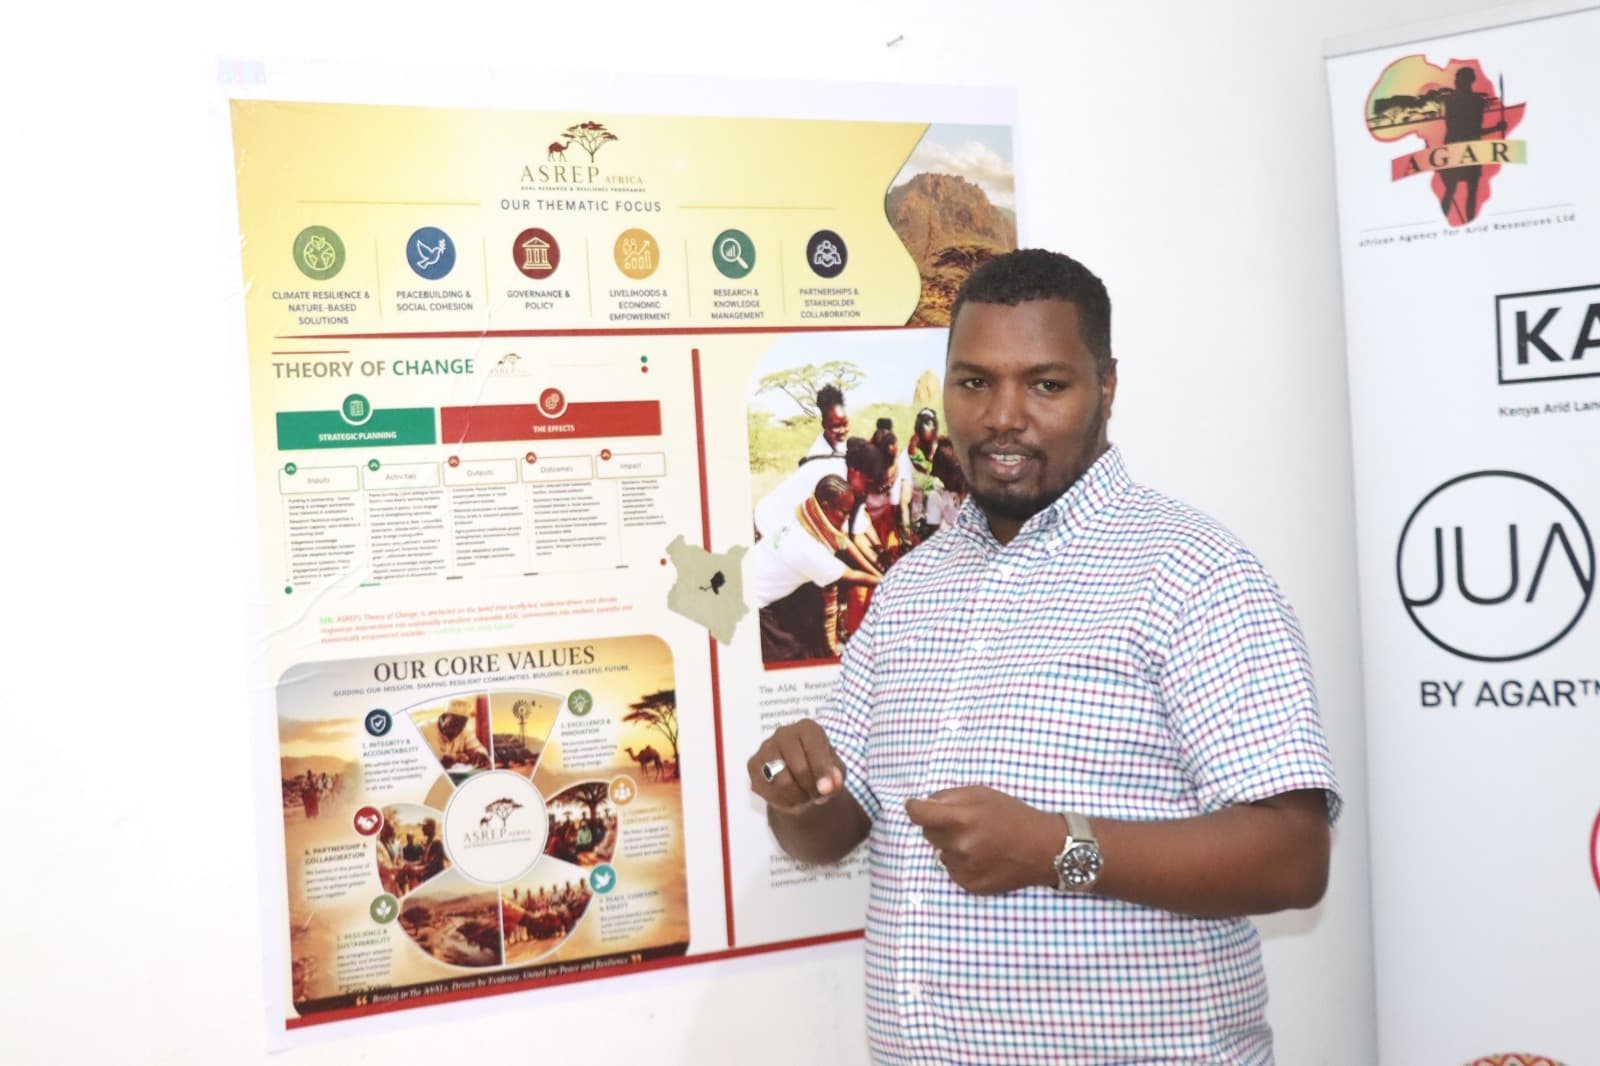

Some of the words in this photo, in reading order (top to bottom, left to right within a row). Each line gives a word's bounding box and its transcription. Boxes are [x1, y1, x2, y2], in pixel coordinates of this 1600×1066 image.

[1403, 142, 1511, 176] AGAR
[520, 165, 599, 183] ASREP
[605, 176, 643, 184] AFRICA
[500, 199, 530, 211] OUR
[537, 199, 609, 212] THEMATIC
[616, 200, 661, 212] FOCUS
[1400, 232, 1438, 243] Agency
[1494, 218, 1551, 230] Resources
[1557, 214, 1575, 223] Ltd
[272, 291, 310, 300] CLIMATE
[313, 291, 360, 300] RESILIENCE
[362, 291, 370, 299] &
[396, 290, 463, 299] PEACEBUILDING
[465, 290, 471, 298] &
[507, 290, 562, 298] GOVERNANCE
[564, 290, 570, 298] &
[609, 289, 659, 297] LIVELIHOODS
[662, 289, 668, 297] &
[713, 289, 751, 297] RESEARCH
[799, 288, 852, 296] PARTNERSHIPS
[854, 288, 859, 296] &
[288, 303, 356, 312] NATURE-BASED
[397, 303, 426, 311] SOCIAL
[429, 303, 473, 311] COHESION
[525, 302, 554, 310] POLICY
[618, 301, 661, 309] ECONOMIC
[713, 300, 760, 308] KNOWLEDGE
[804, 299, 855, 307] STAKEHOLDER
[609, 313, 670, 321] EMPOWERMENT
[711, 312, 764, 320] MANAGEMENT
[801, 310, 861, 318] COLLABORATION
[298, 316, 349, 325] SOLUTIONS
[272, 362, 353, 379] THEORY
[360, 361, 386, 377] OF
[392, 359, 474, 376] CHANGE
[1499, 406, 1539, 418] Kenya
[1544, 401, 1570, 413] Arid
[533, 425, 546, 433] THE
[548, 424, 575, 432] EFFECTS
[319, 432, 358, 442] STRATEGIC
[359, 431, 397, 441] PLANNING
[307, 477, 330, 485] Inputs
[374, 660, 427, 682] OUR
[434, 654, 500, 677] CORE
[507, 644, 595, 670] VALUES
[533, 671, 563, 680] BUILDING
[571, 668, 603, 676] PEACEFUL
[778, 684, 798, 692] ASAL
[1420, 680, 1463, 707] BY
[369, 739, 404, 748] INTEGRITY
[363, 746, 419, 757] ACCOUNTABILITY
[312, 843, 361, 854] PARTNERSHIP
[304, 852, 366, 865] COLLABORATION
[452, 981, 476, 992] Driven
